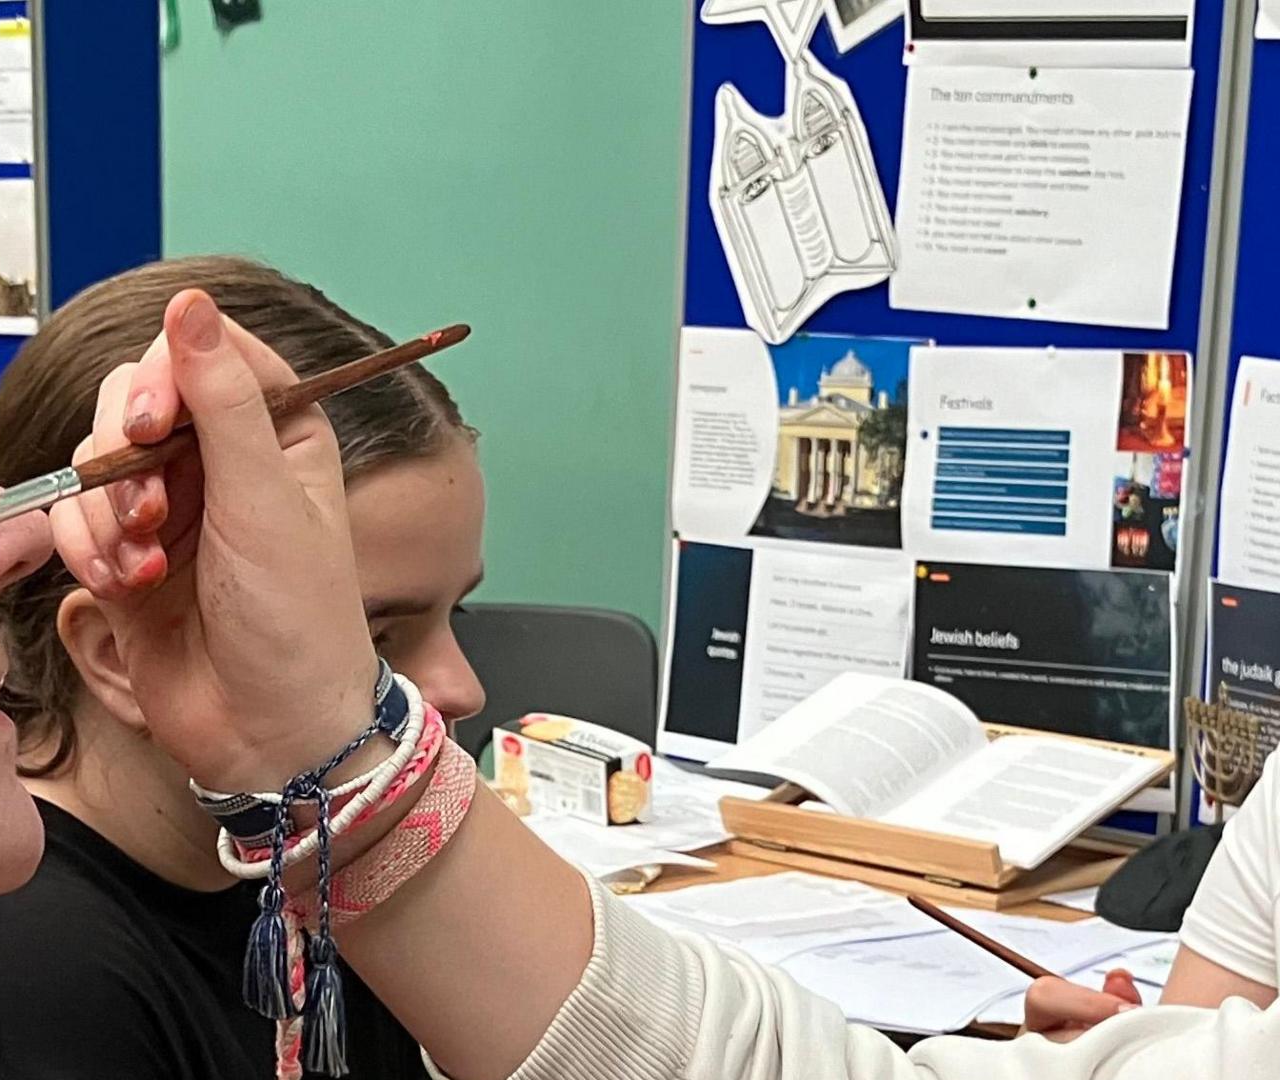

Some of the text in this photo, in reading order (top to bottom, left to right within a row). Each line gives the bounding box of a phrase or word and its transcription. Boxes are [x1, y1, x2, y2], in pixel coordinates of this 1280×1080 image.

[939, 394, 994, 411] Festivals
[929, 627, 1020, 650] Jewish beliefs
[1221, 656, 1238, 676] the
